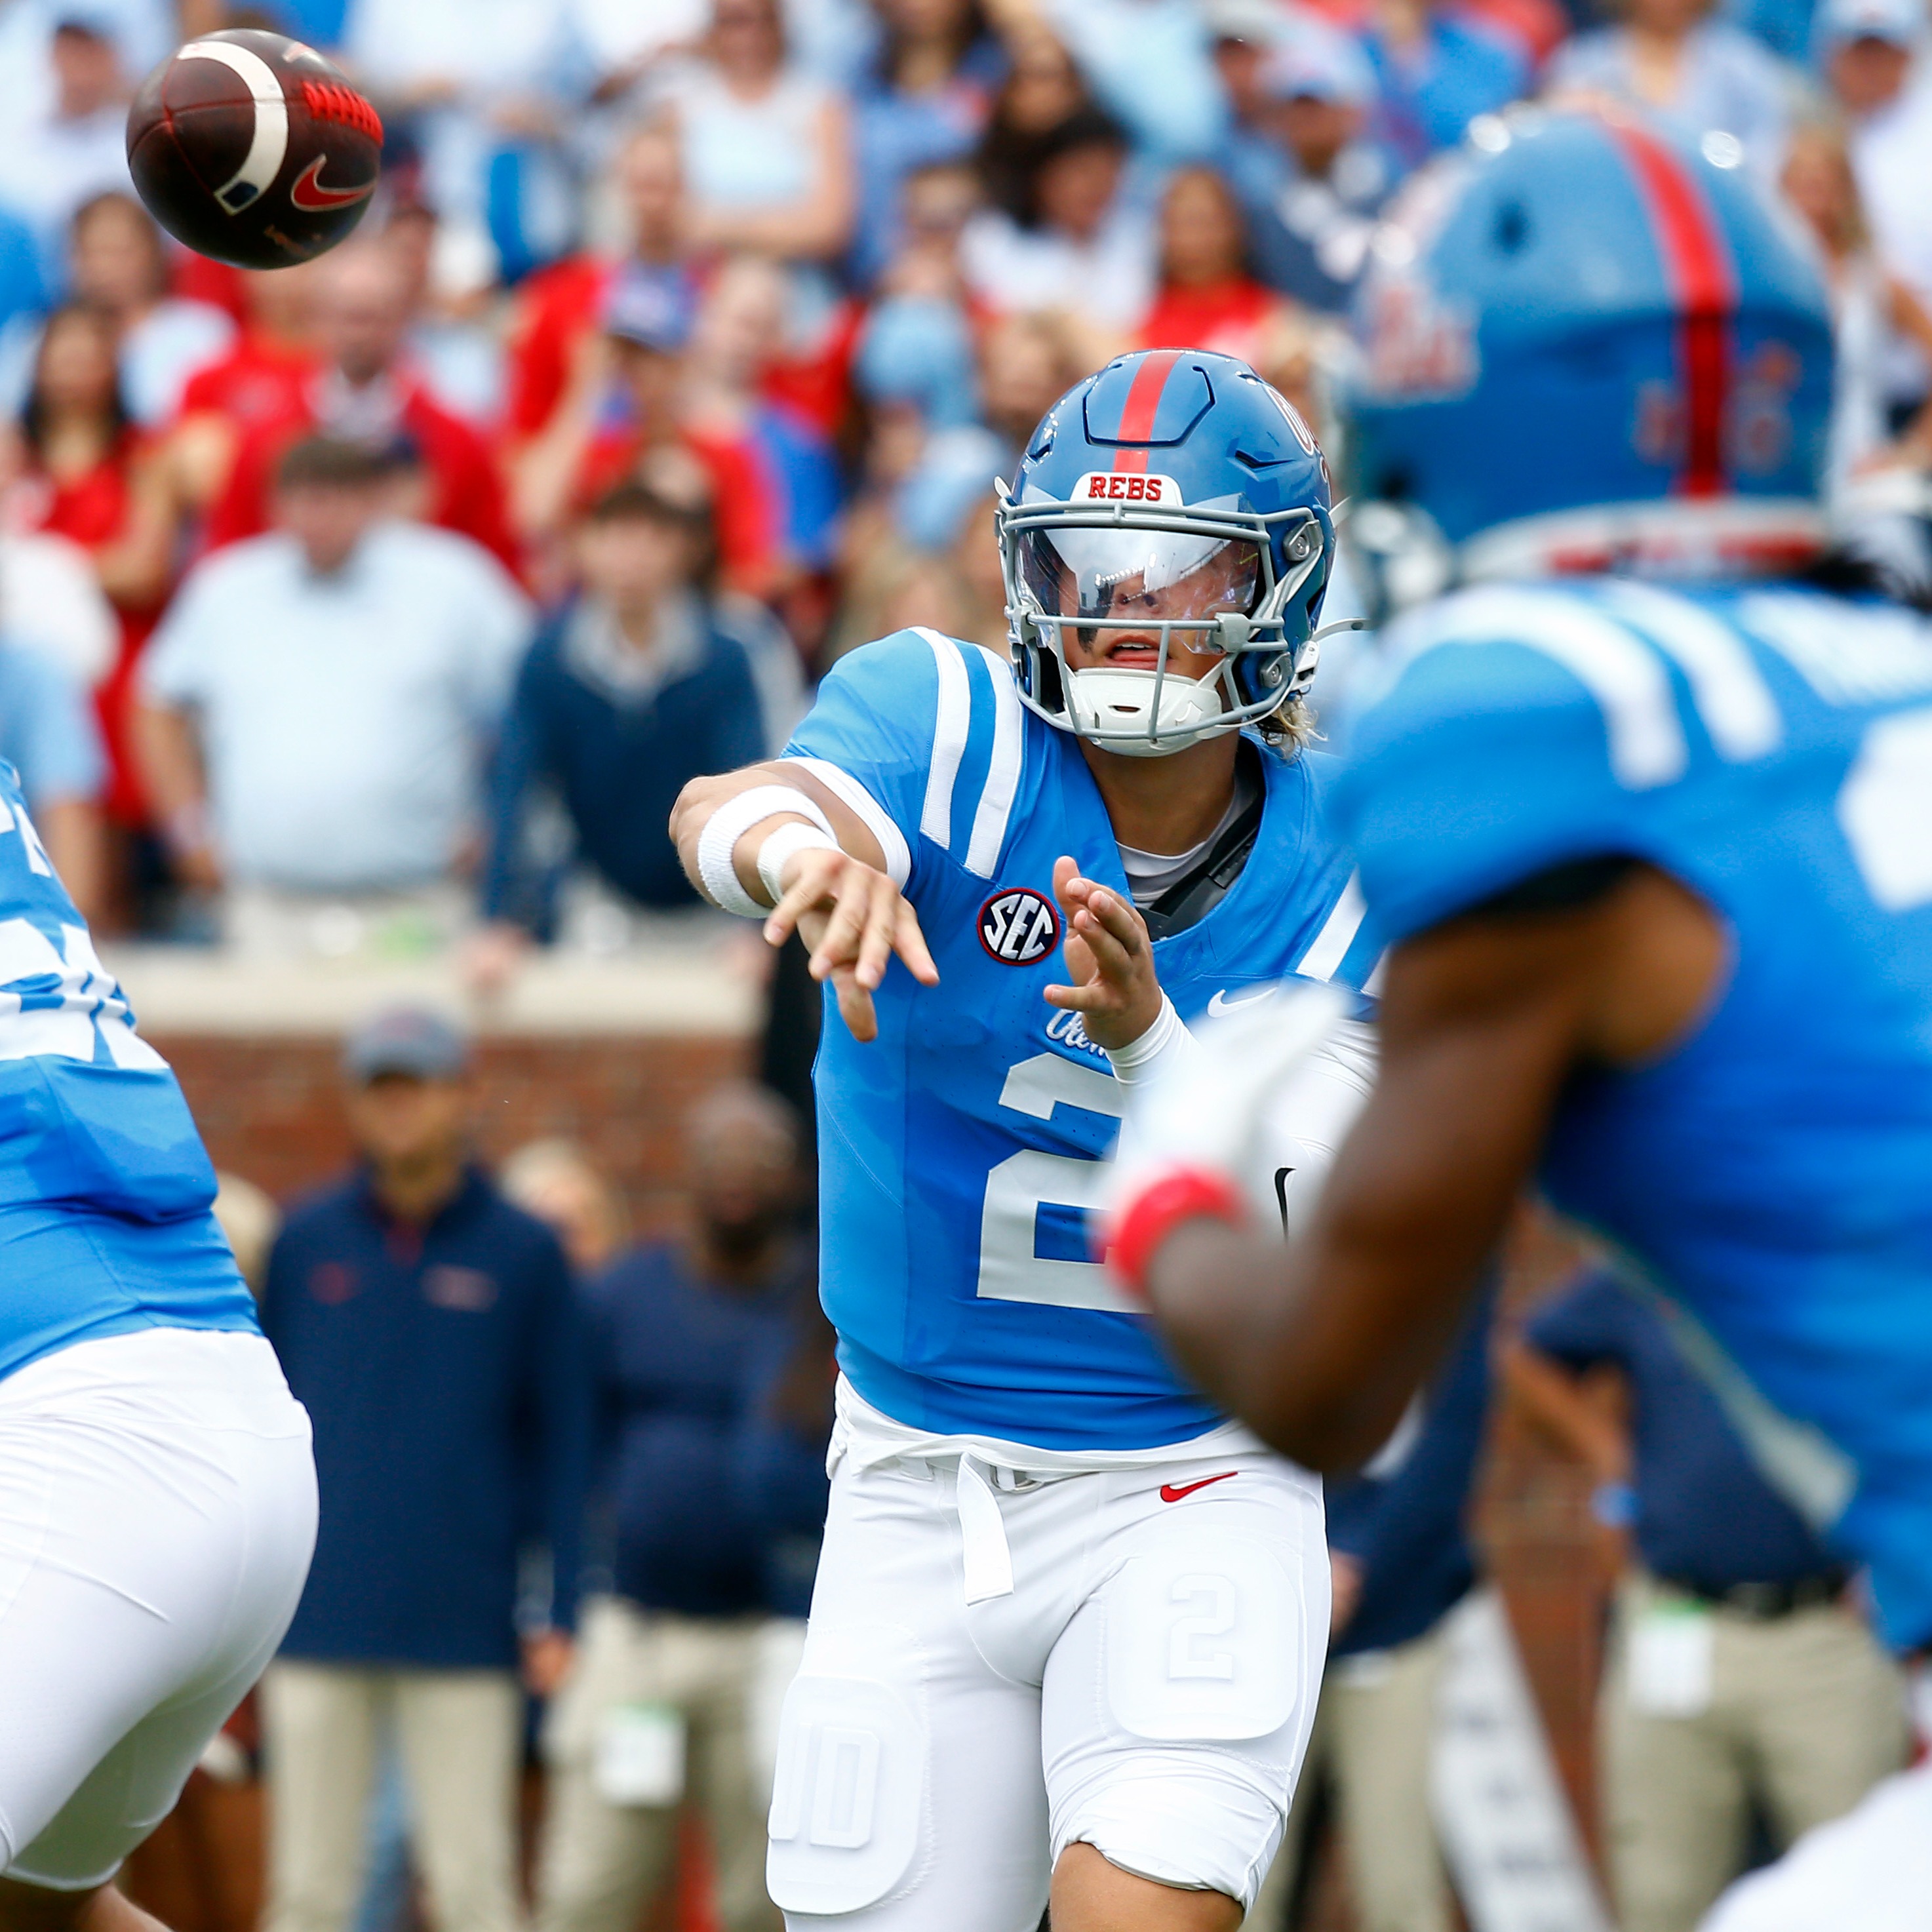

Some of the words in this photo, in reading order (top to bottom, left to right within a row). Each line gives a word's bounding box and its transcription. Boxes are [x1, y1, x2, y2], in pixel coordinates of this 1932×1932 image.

[1088, 475, 1162, 502] REBS
[983, 893, 1054, 960] SEC
[977, 1052, 1137, 1313] 2
[1168, 1575, 1236, 1681] 2
